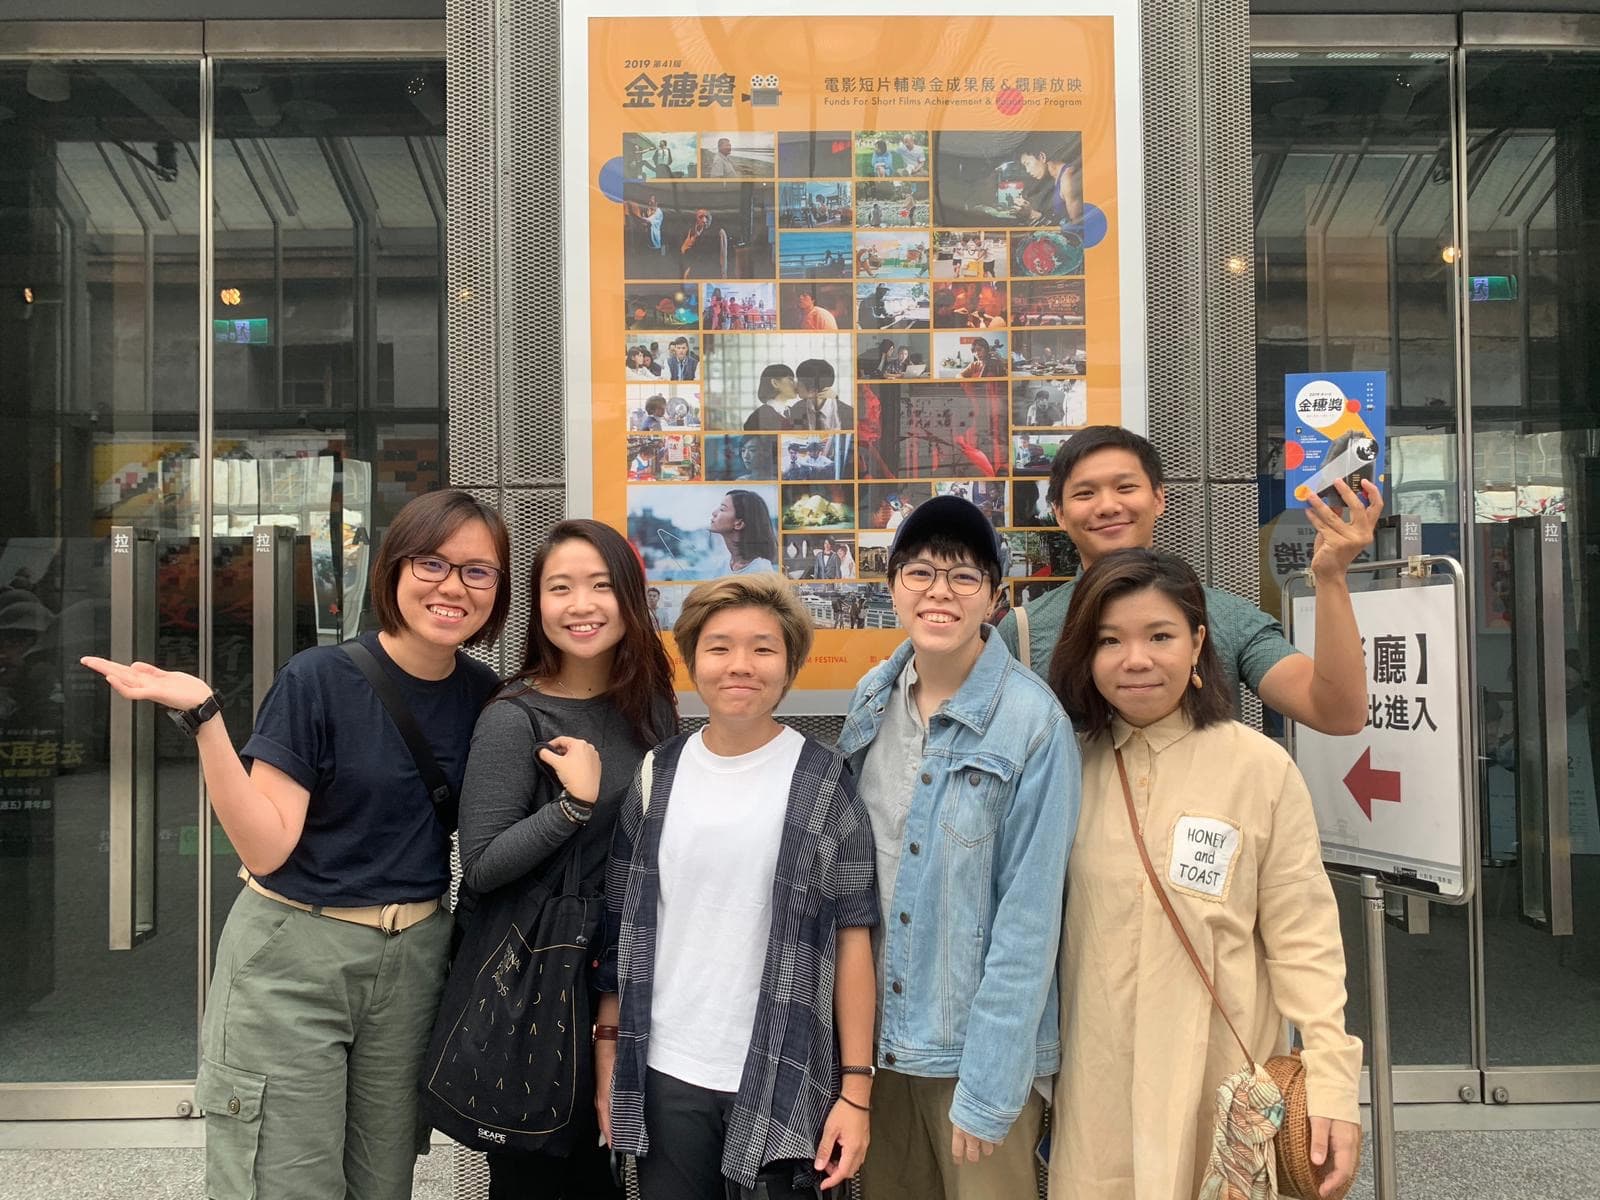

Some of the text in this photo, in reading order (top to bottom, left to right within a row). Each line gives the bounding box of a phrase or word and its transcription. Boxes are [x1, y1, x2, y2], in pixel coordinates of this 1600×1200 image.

[624, 60, 650, 69] 2019
[622, 72, 736, 108] 金穗獎
[824, 97, 850, 106] Funds
[853, 97, 868, 106] For
[871, 97, 896, 106] Short
[899, 97, 921, 106] Films
[924, 97, 982, 106] Achievement
[1044, 97, 1082, 108] Program
[1405, 522, 1418, 536] 拉
[1545, 523, 1558, 537] 拉
[114, 533, 129, 548] 拉
[256, 533, 271, 548] 拉
[814, 656, 848, 664] FESTIVAL
[1361, 633, 1428, 685] 廳】
[1187, 827, 1227, 849] HONEY
[1194, 850, 1216, 865] and
[1180, 863, 1221, 887] TOAST
